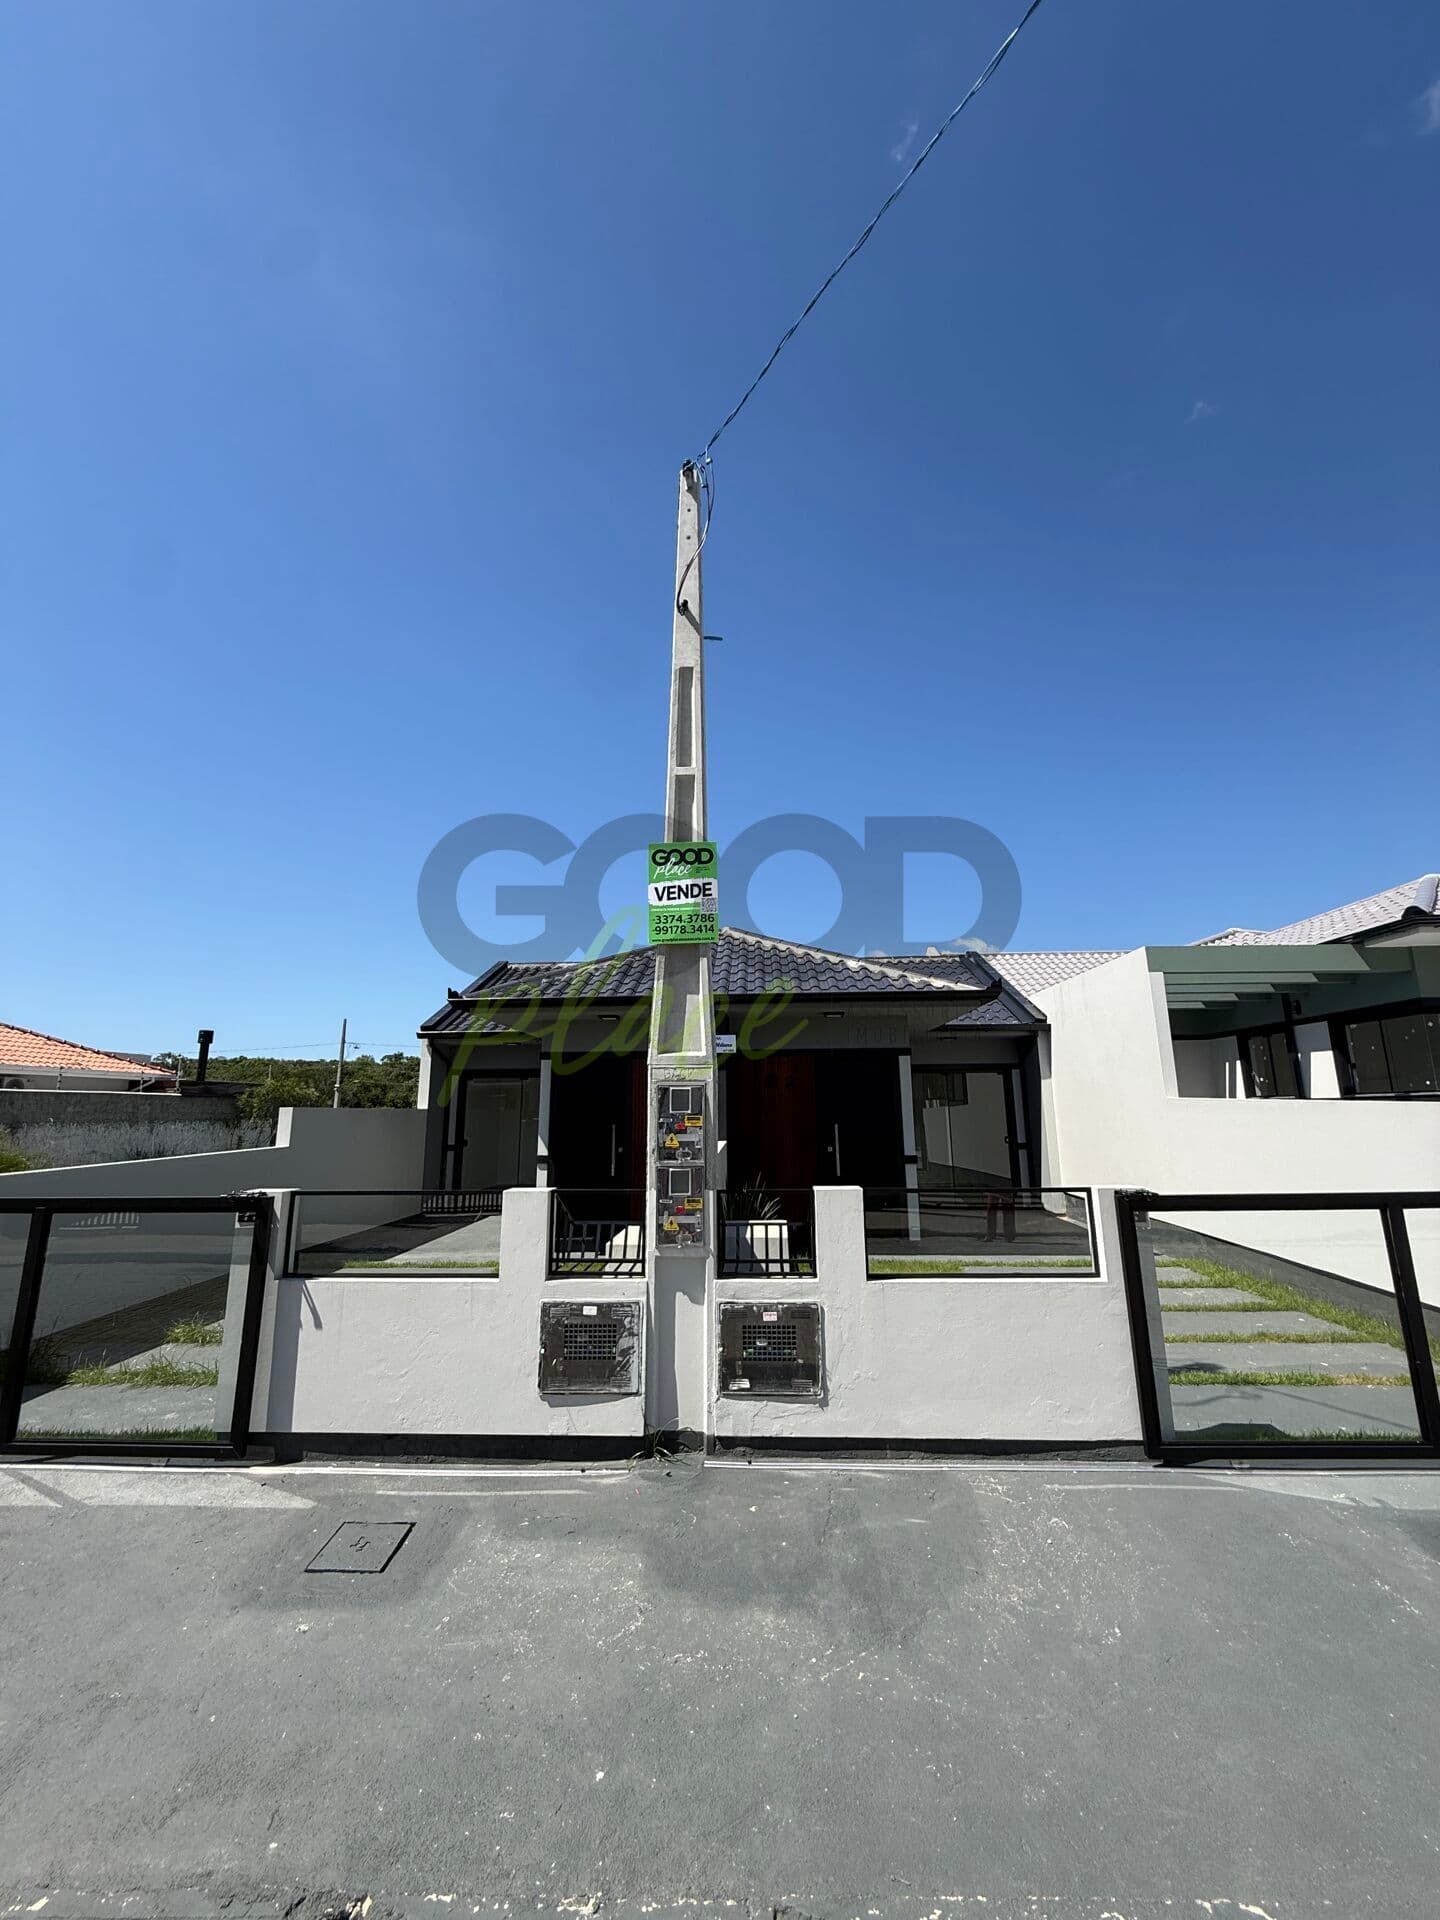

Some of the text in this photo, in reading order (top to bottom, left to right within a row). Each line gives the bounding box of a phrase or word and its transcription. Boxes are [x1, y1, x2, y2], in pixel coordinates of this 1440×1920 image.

[652, 848, 714, 866] GOOD
[653, 857, 692, 879] place
[654, 882, 712, 901] VENDE
